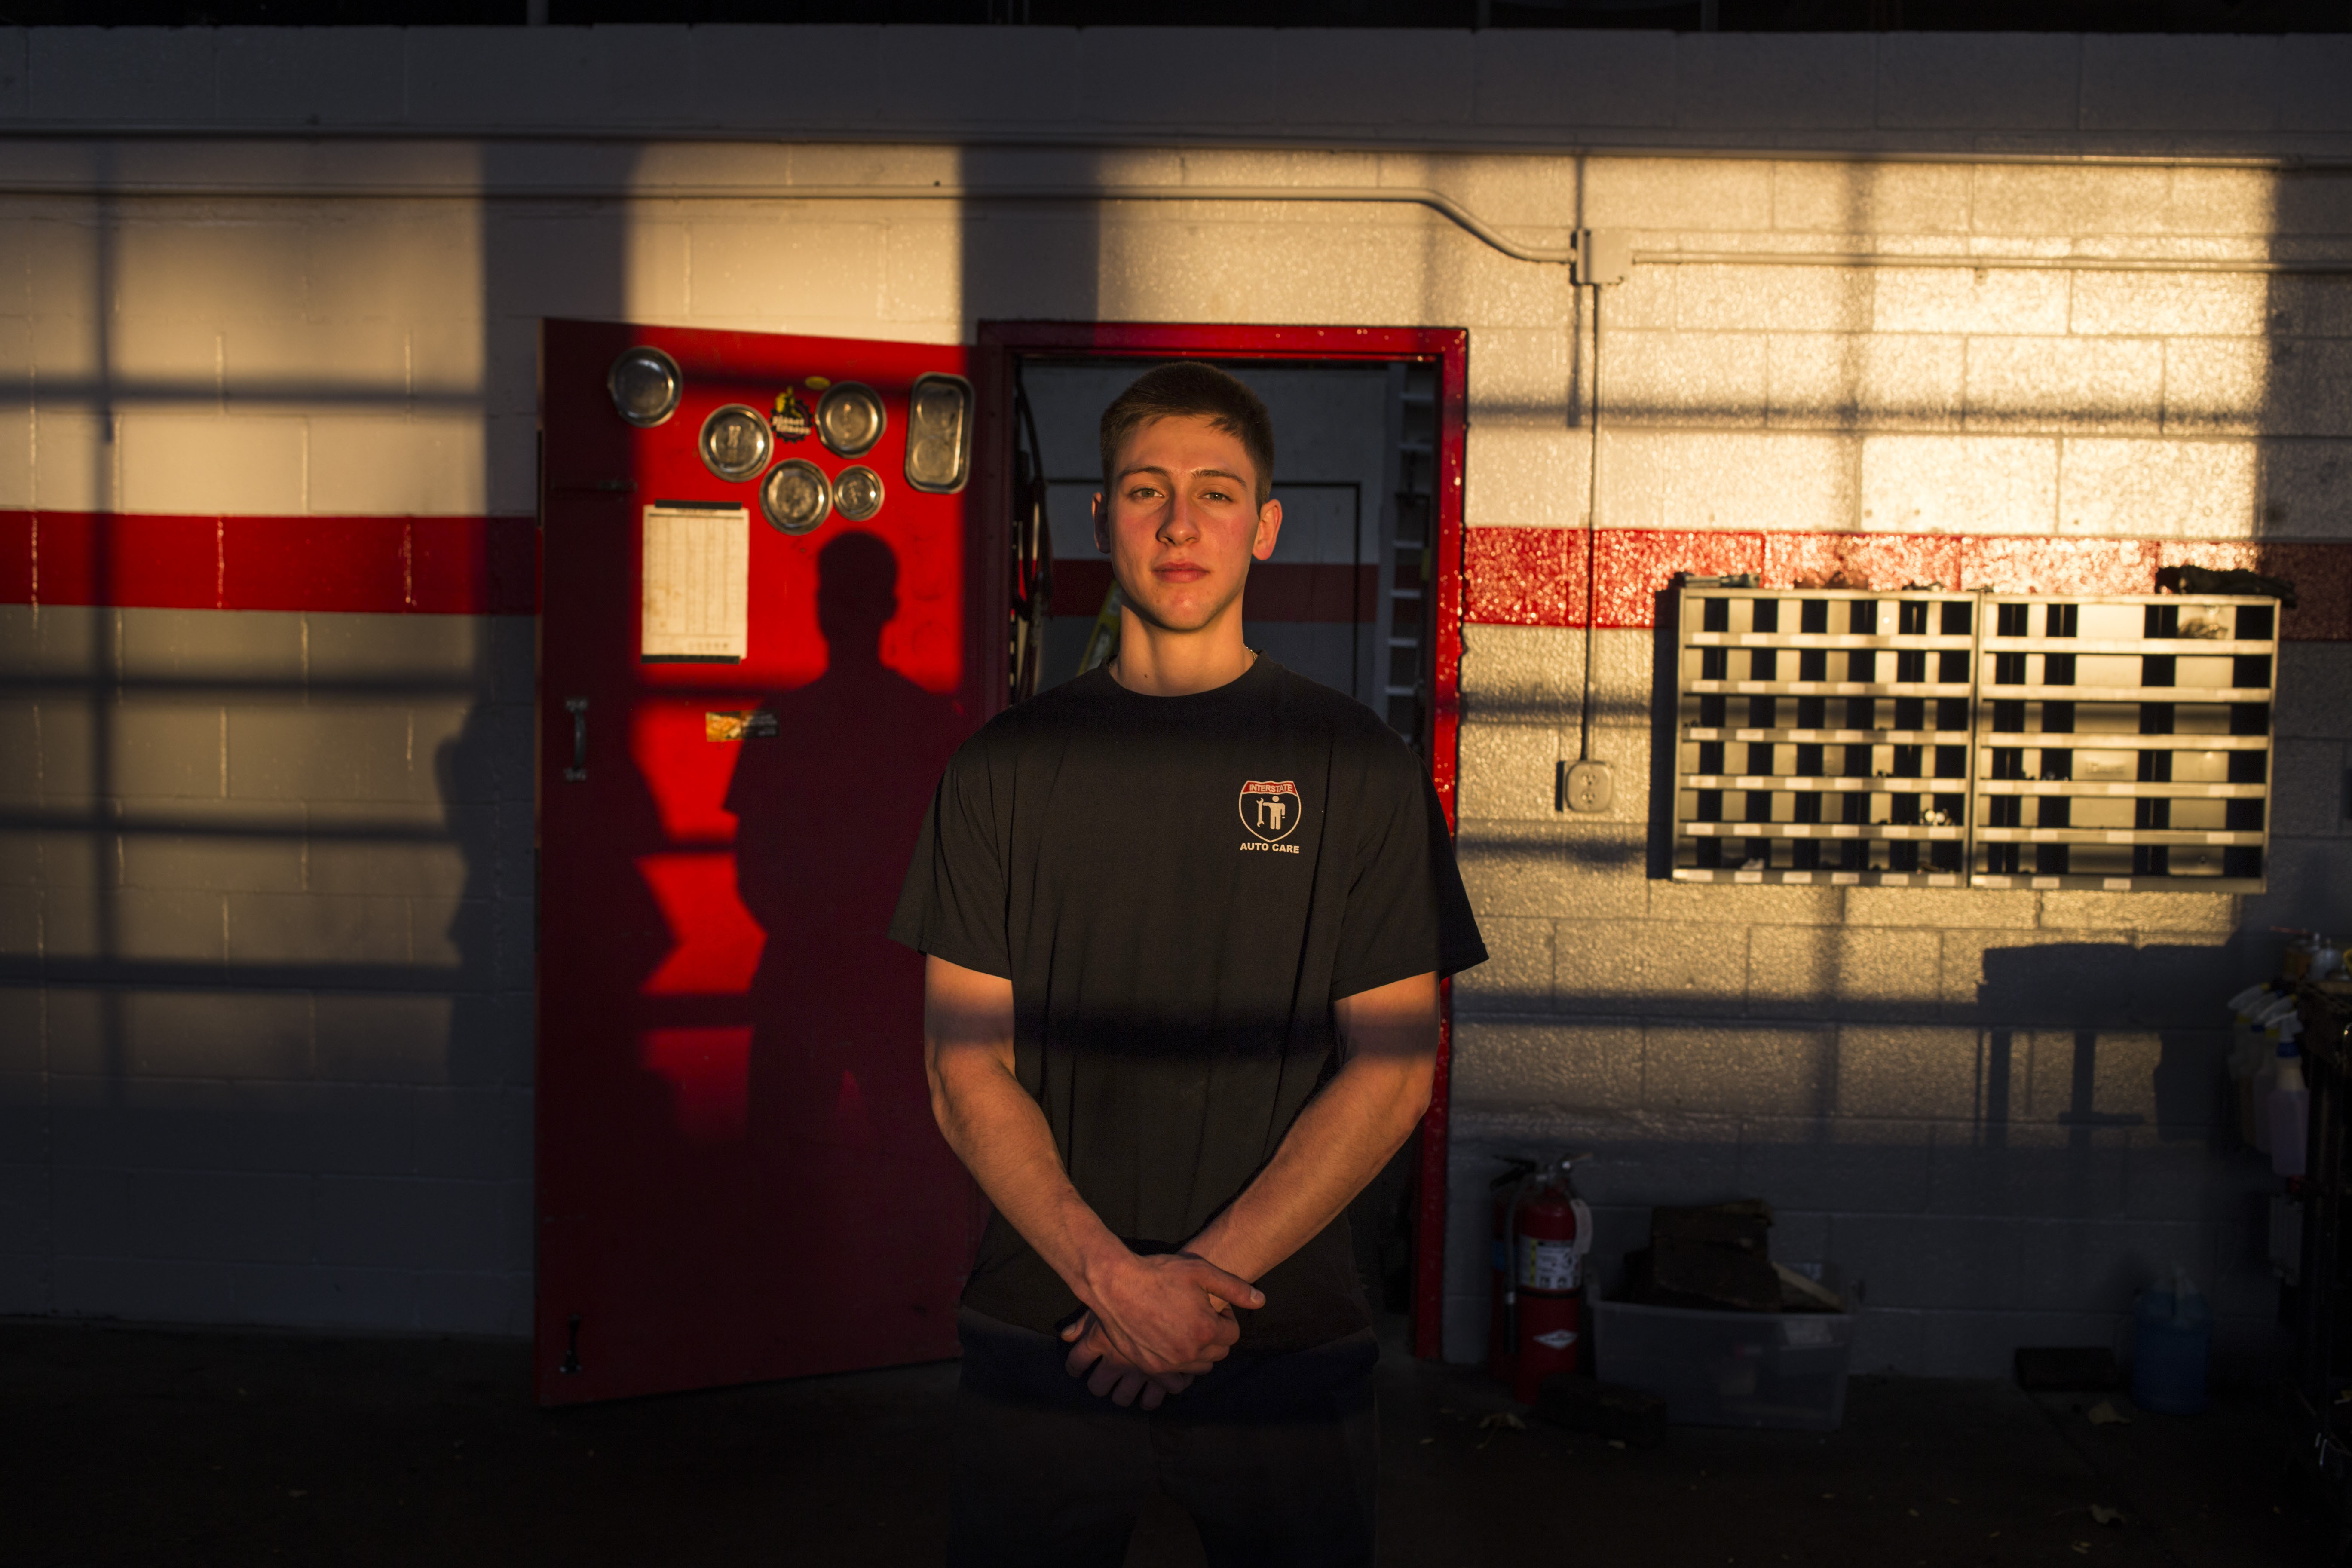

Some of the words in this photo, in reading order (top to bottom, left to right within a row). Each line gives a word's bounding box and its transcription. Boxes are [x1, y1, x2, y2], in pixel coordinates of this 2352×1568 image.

[1250, 784, 1292, 792] INTERSTATE
[1240, 843, 1269, 851] AUTO
[1272, 844, 1299, 854] CARE
